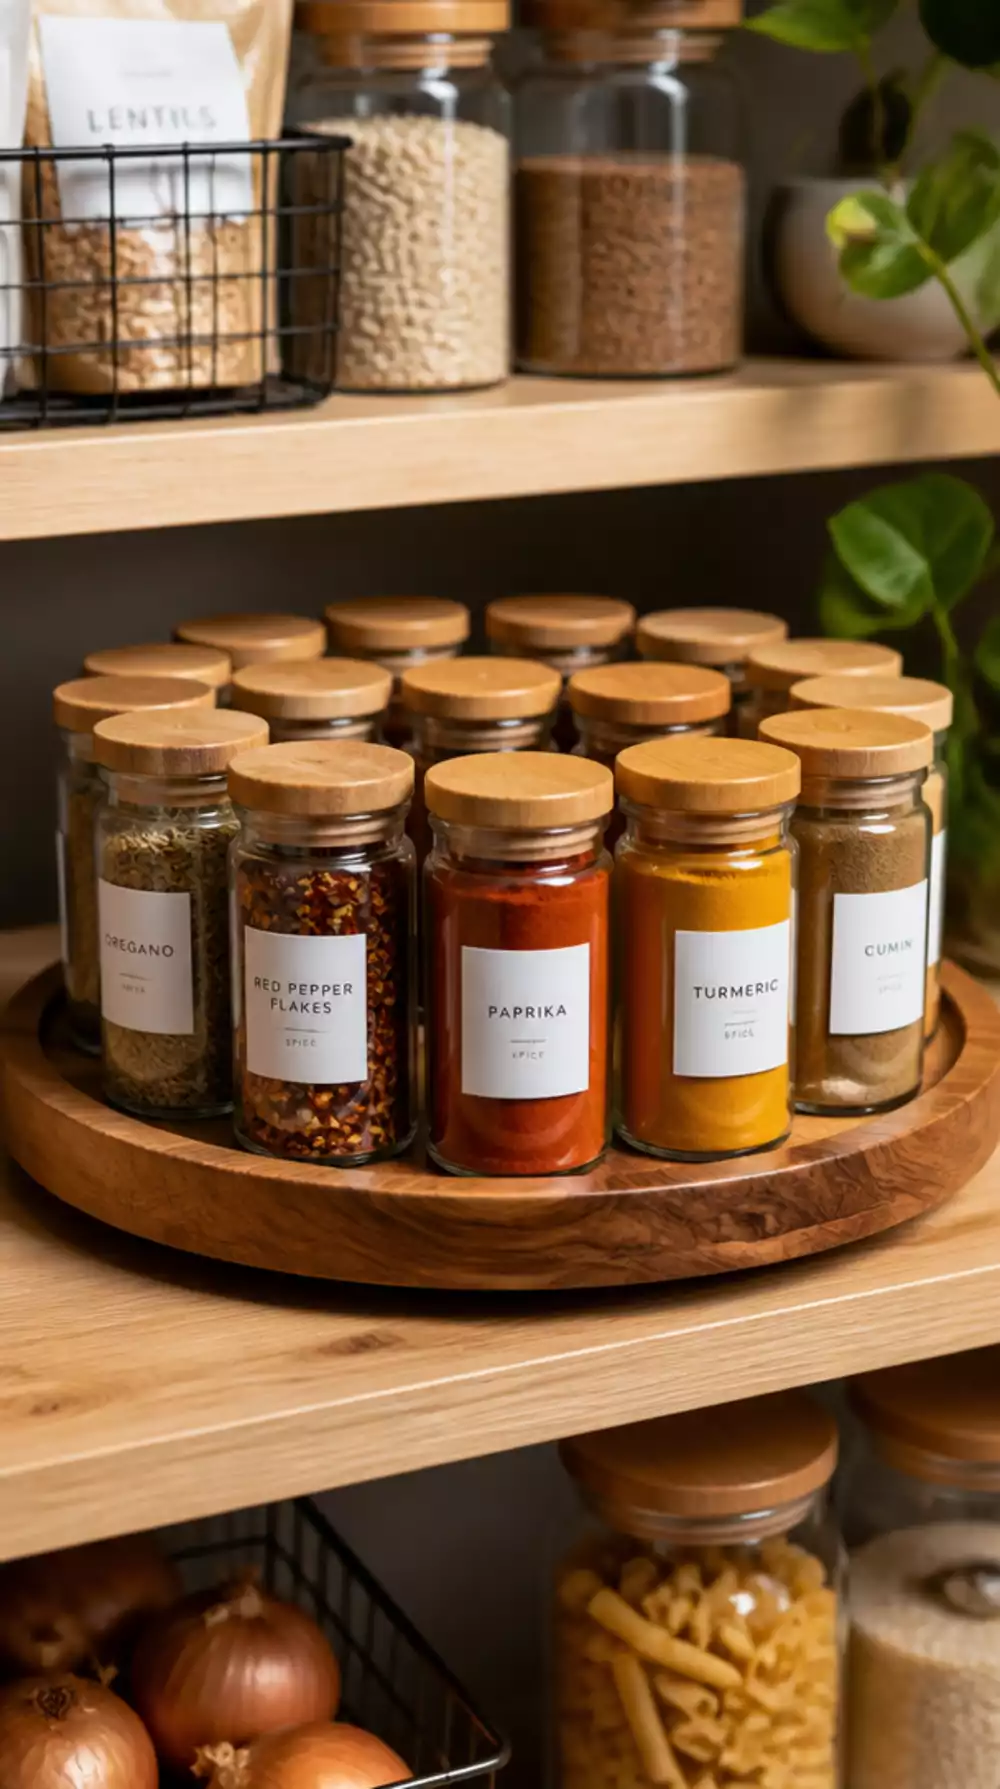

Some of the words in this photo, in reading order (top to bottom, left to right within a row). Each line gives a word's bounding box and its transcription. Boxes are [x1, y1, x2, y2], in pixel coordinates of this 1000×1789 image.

[87, 105, 217, 133] LENTILS
[105, 933, 174, 957] OREGANO
[864, 939, 913, 957] CUMIN
[254, 976, 280, 993] RED
[288, 983, 353, 997] PEPPER
[693, 978, 778, 999] TURMERIC
[270, 997, 332, 1014] FLAKES
[488, 1004, 567, 1019] PAPRIKA
